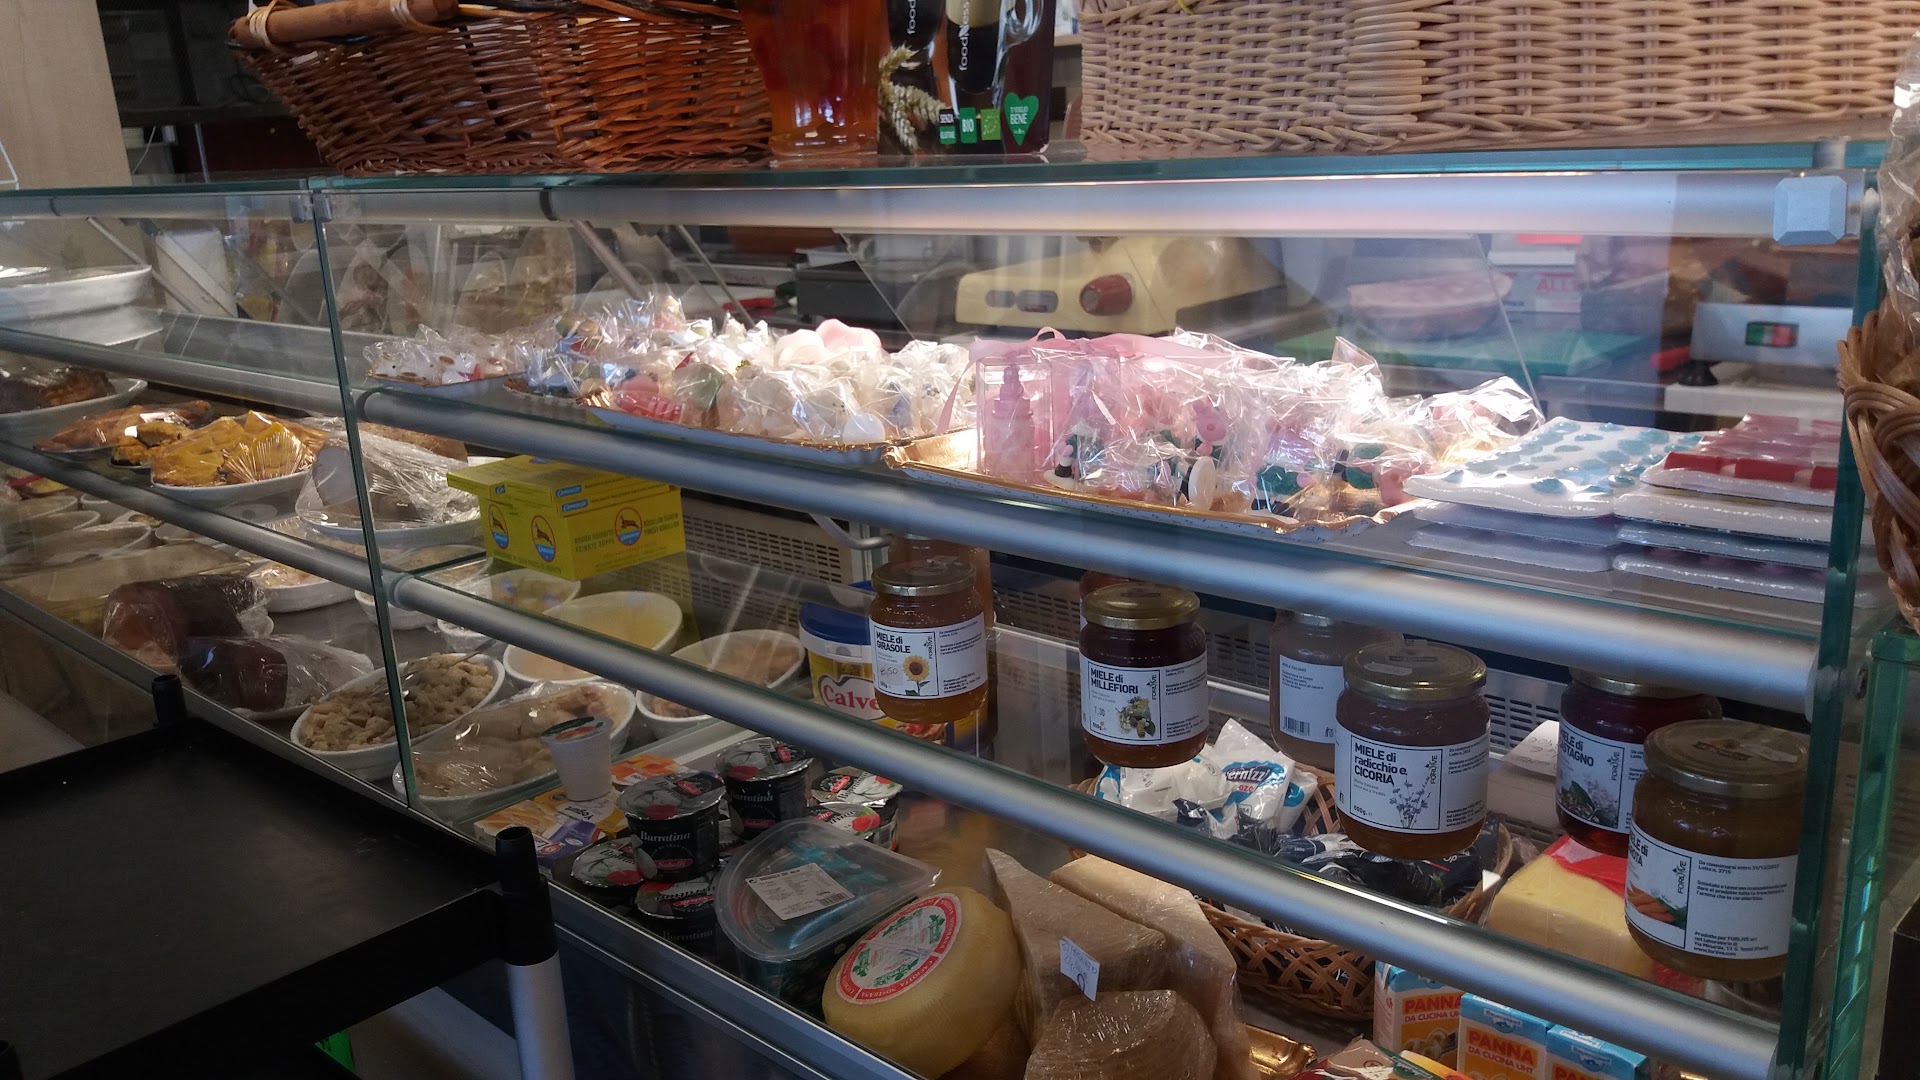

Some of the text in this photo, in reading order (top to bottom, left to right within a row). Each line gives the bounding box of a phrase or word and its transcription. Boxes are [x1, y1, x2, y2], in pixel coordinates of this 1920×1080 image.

[961, 118, 975, 132] BIO
[1009, 113, 1028, 125] BENE
[876, 631, 904, 645] MIELE di
[876, 640, 911, 654] GIRASOLE
[1090, 667, 1124, 683] MIELE di
[1091, 677, 1139, 695] MILLEFIORI
[1355, 742, 1397, 763] MIELE di
[1575, 741, 1584, 751] di
[1354, 755, 1398, 774] radicchio
[1354, 765, 1394, 785] CICORIA
[640, 830, 691, 842] Burratina
[1640, 844, 1648, 857] di
[1404, 1015, 1416, 1023] DA
[1417, 1012, 1448, 1020] CUCINA
[1468, 1029, 1535, 1065] PANNA
[1468, 1045, 1534, 1074] DA CUCINA UHT
